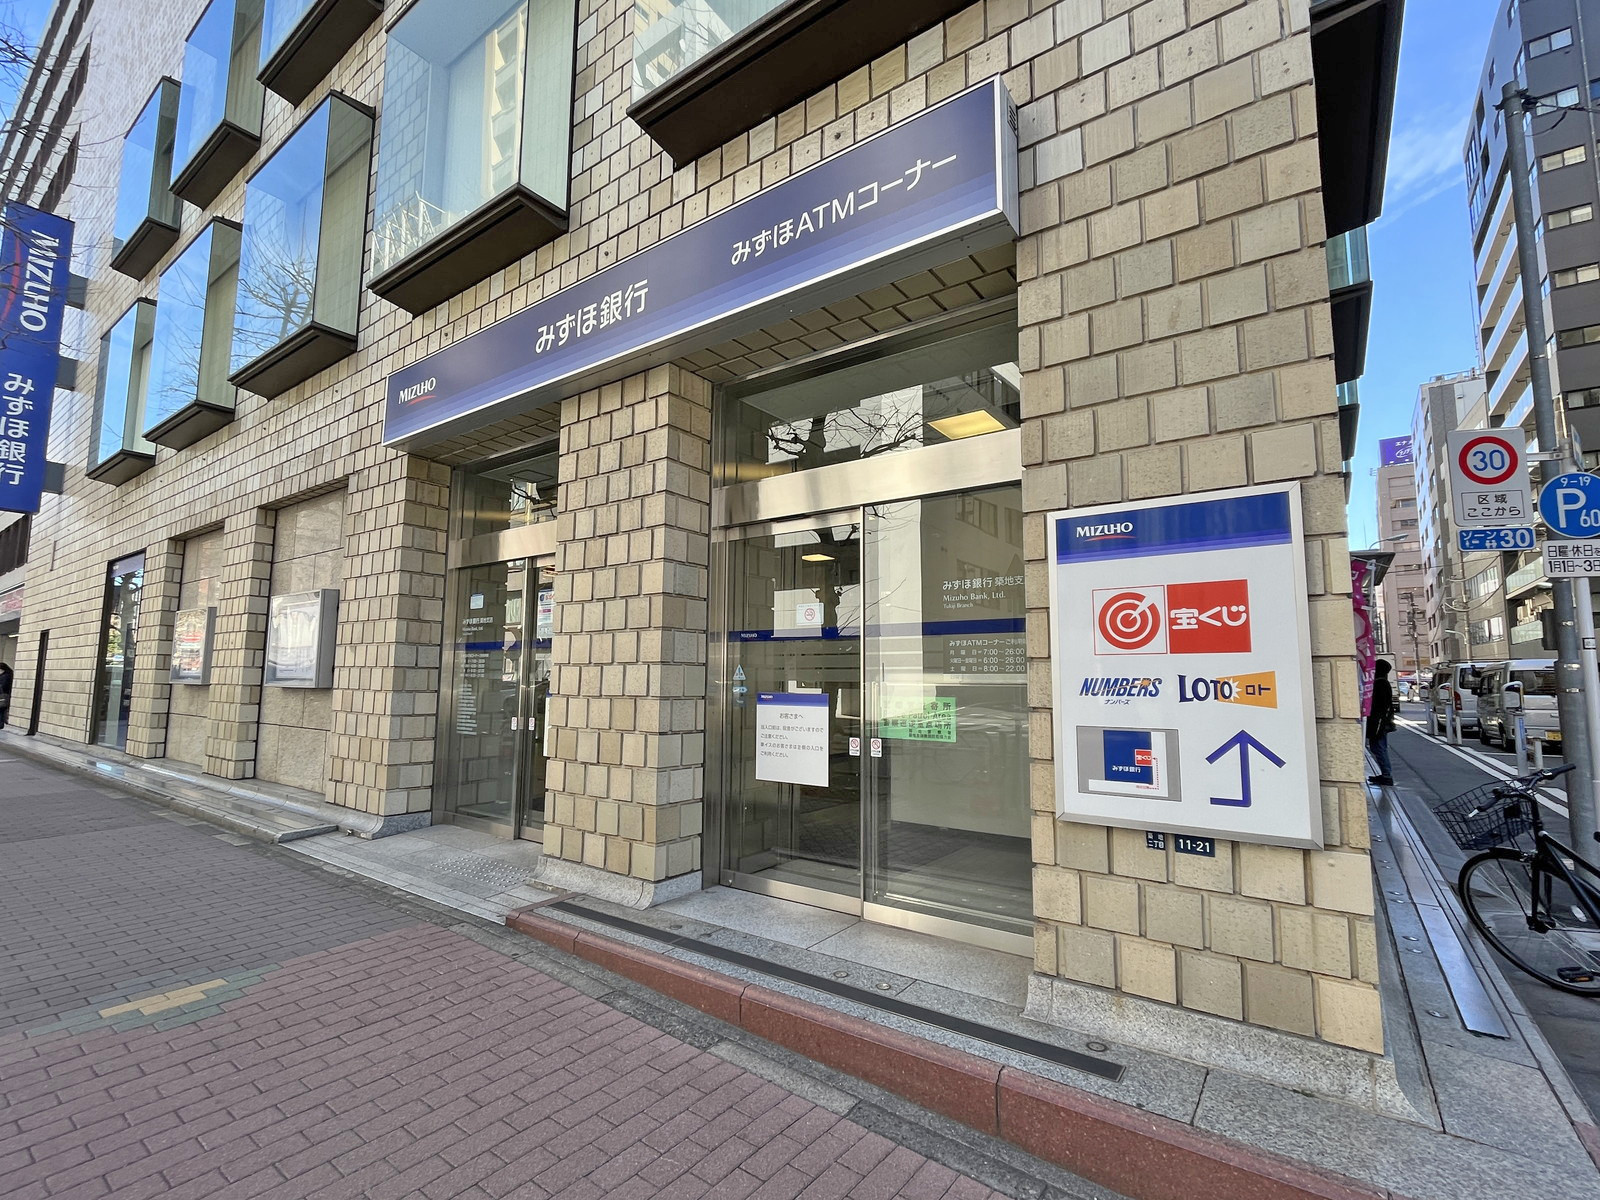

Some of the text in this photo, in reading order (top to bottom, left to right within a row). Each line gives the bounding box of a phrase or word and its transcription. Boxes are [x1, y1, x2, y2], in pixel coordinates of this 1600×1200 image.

[731, 154, 957, 265] みずほATMコーナー
[20, 229, 59, 332] MIZUHO
[535, 279, 648, 353] みずほ銀行
[398, 377, 436, 405] MIZUHO
[0, 372, 35, 485] みずほ銀行
[1473, 449, 1505, 472] 30
[1560, 476, 1591, 487] 9-19
[1477, 494, 1508, 505] 区域
[1556, 488, 1587, 528] P
[1467, 506, 1521, 518] ここから
[1580, 509, 1600, 527] 60
[1076, 522, 1134, 538] MIZUHO
[942, 577, 993, 591] みずほ銀行
[943, 590, 1006, 602] Mizuho Bank, Ltd.
[1170, 604, 1247, 630] 宝くじ
[1079, 677, 1163, 698] NUMBERS
[1177, 673, 1234, 703] LOTO
[779, 712, 804, 720] お客さまへ
[1179, 838, 1210, 853] 11-21
